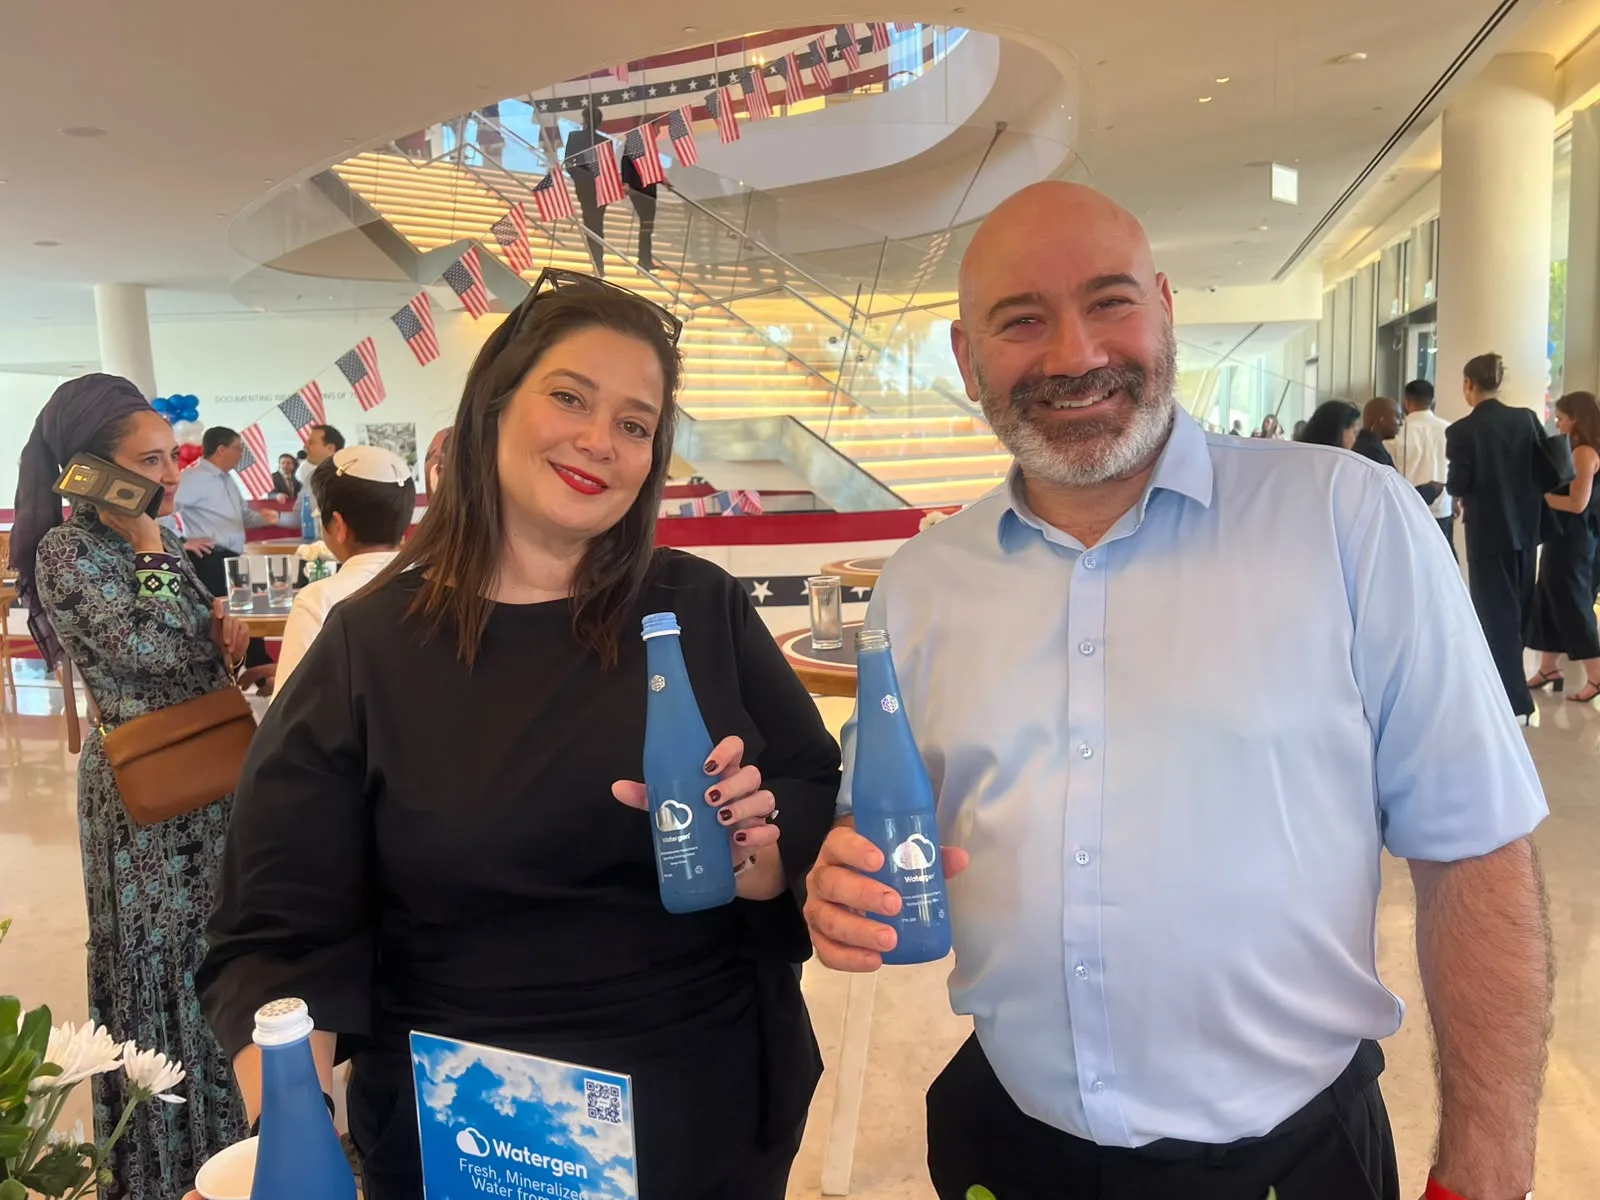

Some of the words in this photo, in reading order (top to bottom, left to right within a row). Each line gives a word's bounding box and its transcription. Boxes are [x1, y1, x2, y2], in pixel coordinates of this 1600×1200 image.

[214, 394, 273, 404] DOCUMENTING
[459, 1157, 502, 1184] Fresh,
[492, 1138, 589, 1179] Watergen
[471, 1174, 513, 1197] Water
